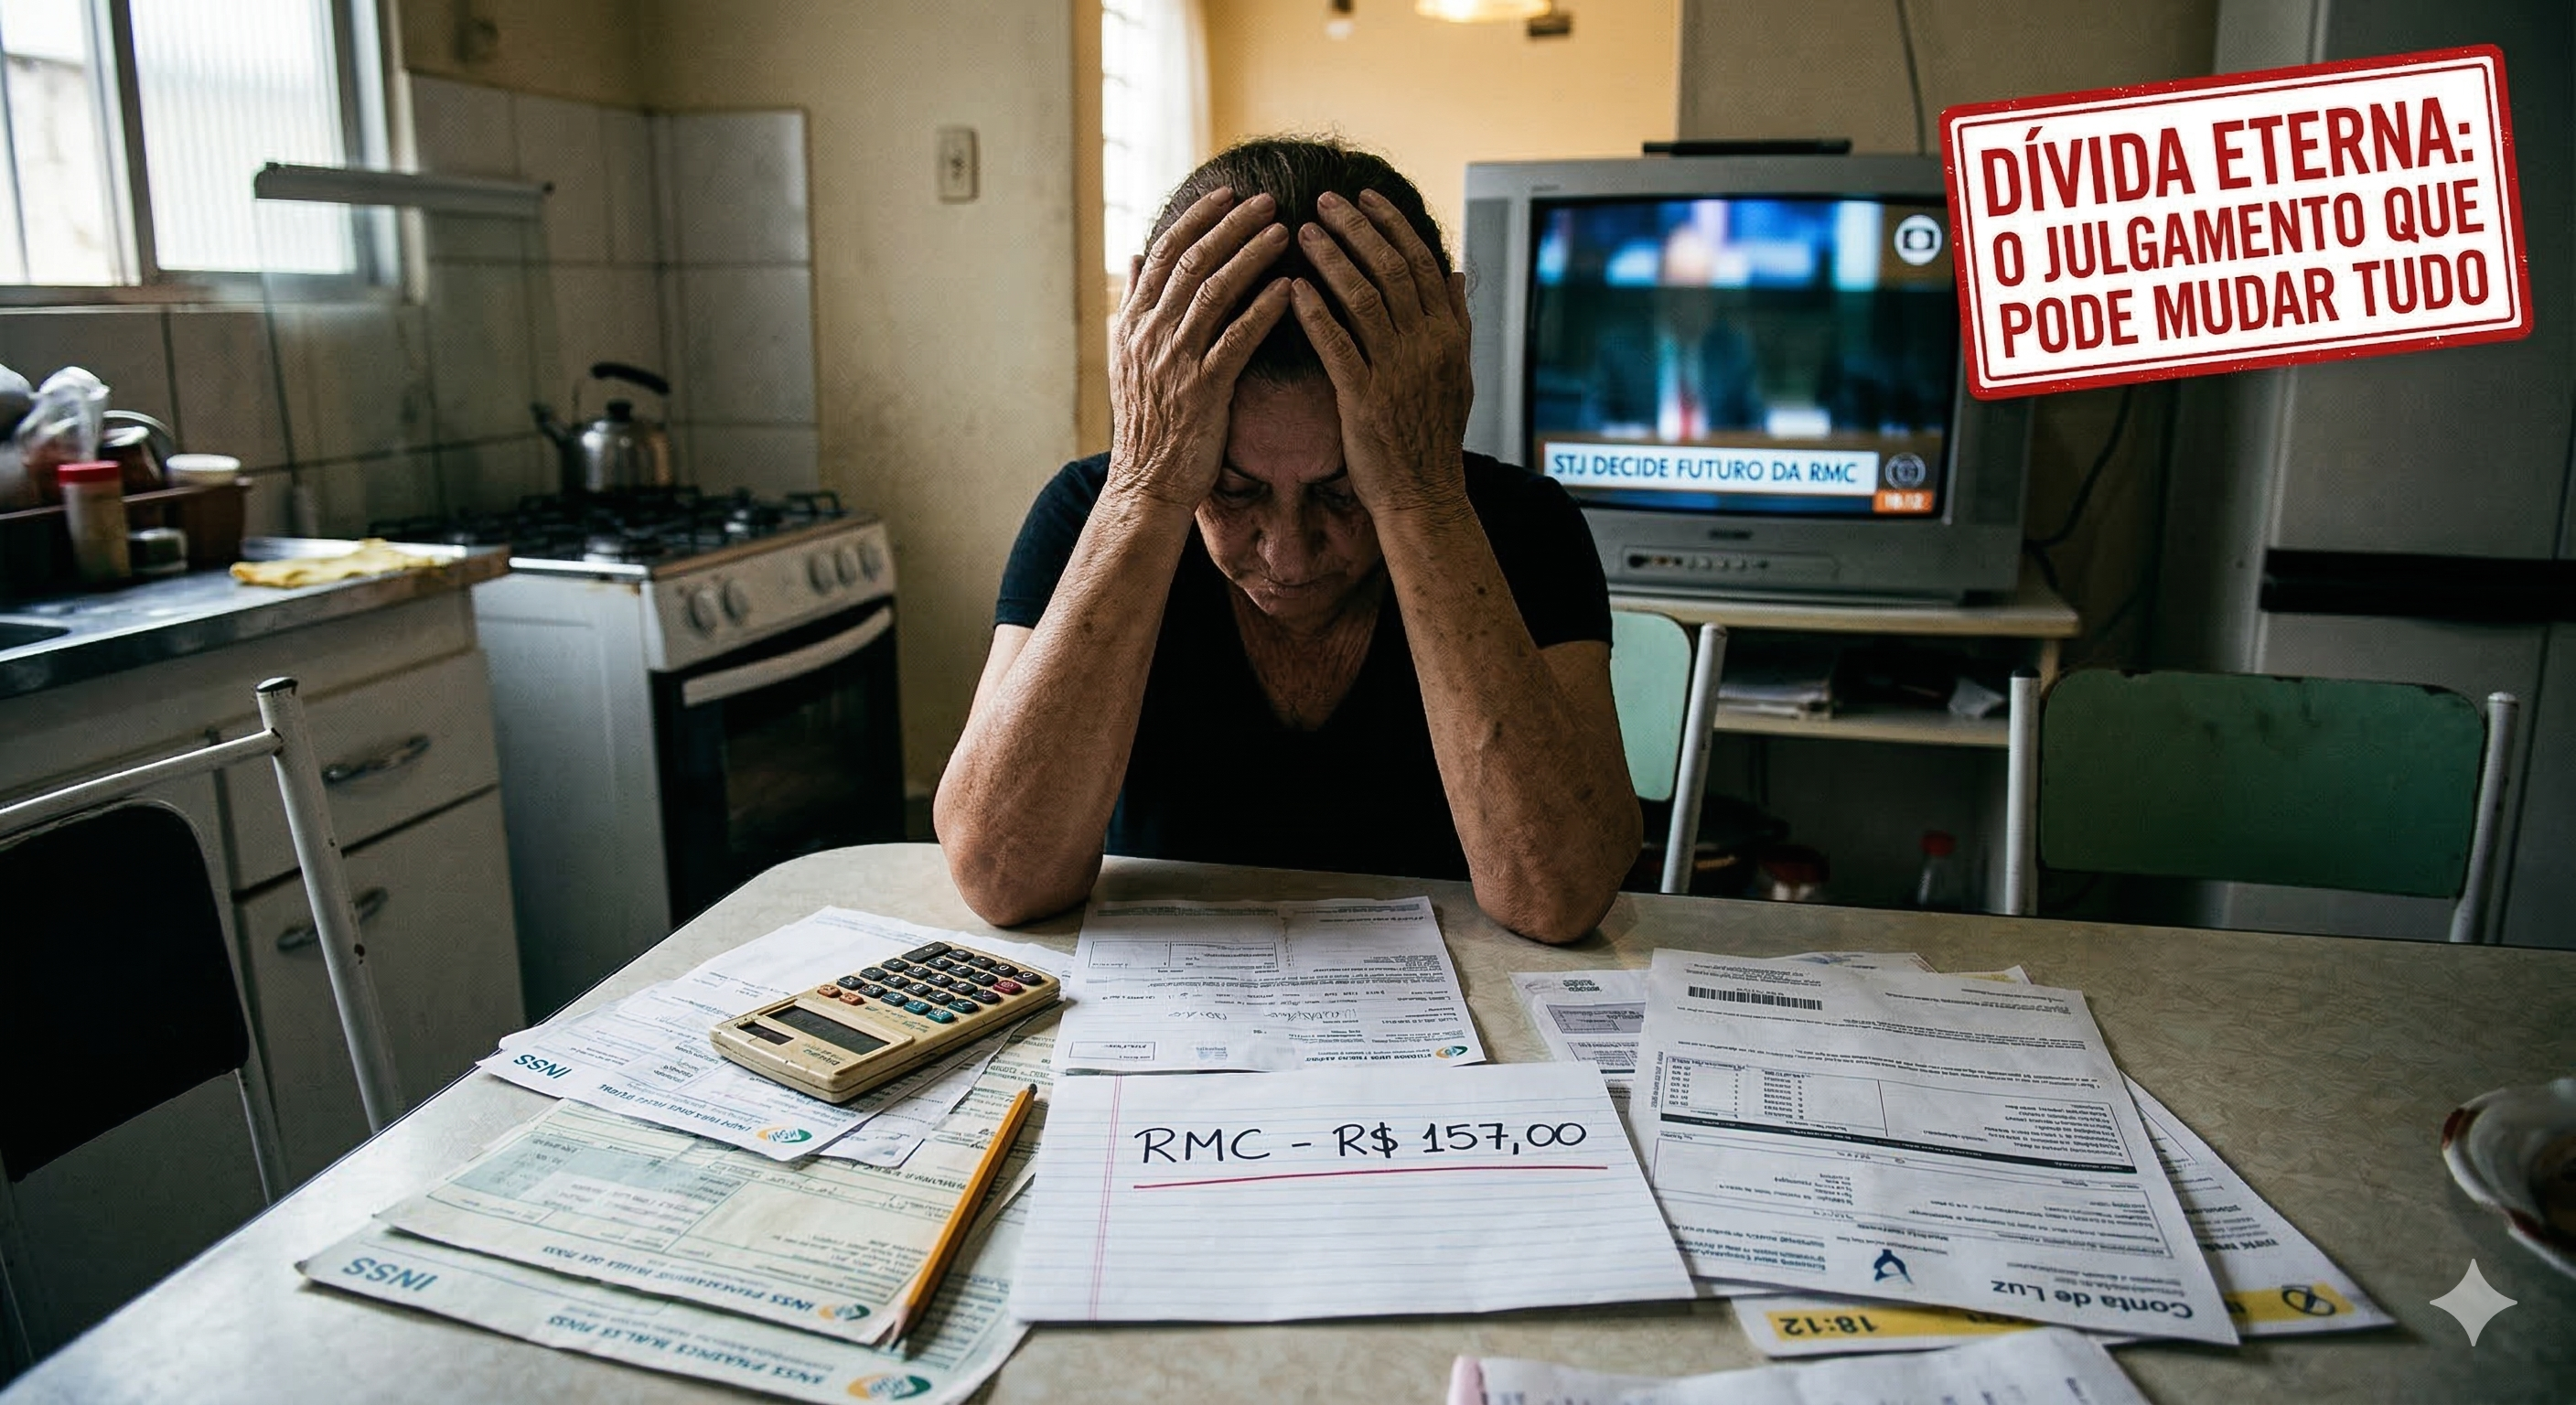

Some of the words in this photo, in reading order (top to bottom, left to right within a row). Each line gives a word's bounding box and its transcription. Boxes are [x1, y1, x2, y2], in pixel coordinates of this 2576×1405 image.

[1554, 454, 1587, 477] STJ
[1594, 455, 1669, 478] DECIDE
[1677, 458, 1764, 481] FUTURO
[1772, 460, 1802, 482] DA
[1809, 461, 1858, 484] RMC
[513, 1054, 573, 1079] INSS
[1134, 1127, 1271, 1164] RMC
[1332, 1121, 1399, 1160] R$
[1422, 1121, 1588, 1156] 157,00
[341, 1255, 439, 1292] INSS
[1991, 1281, 2046, 1303] Luz
[2055, 1290, 2092, 1306] de
[2102, 1294, 2194, 1319] Conta
[1784, 1314, 1879, 1336] 18:12
